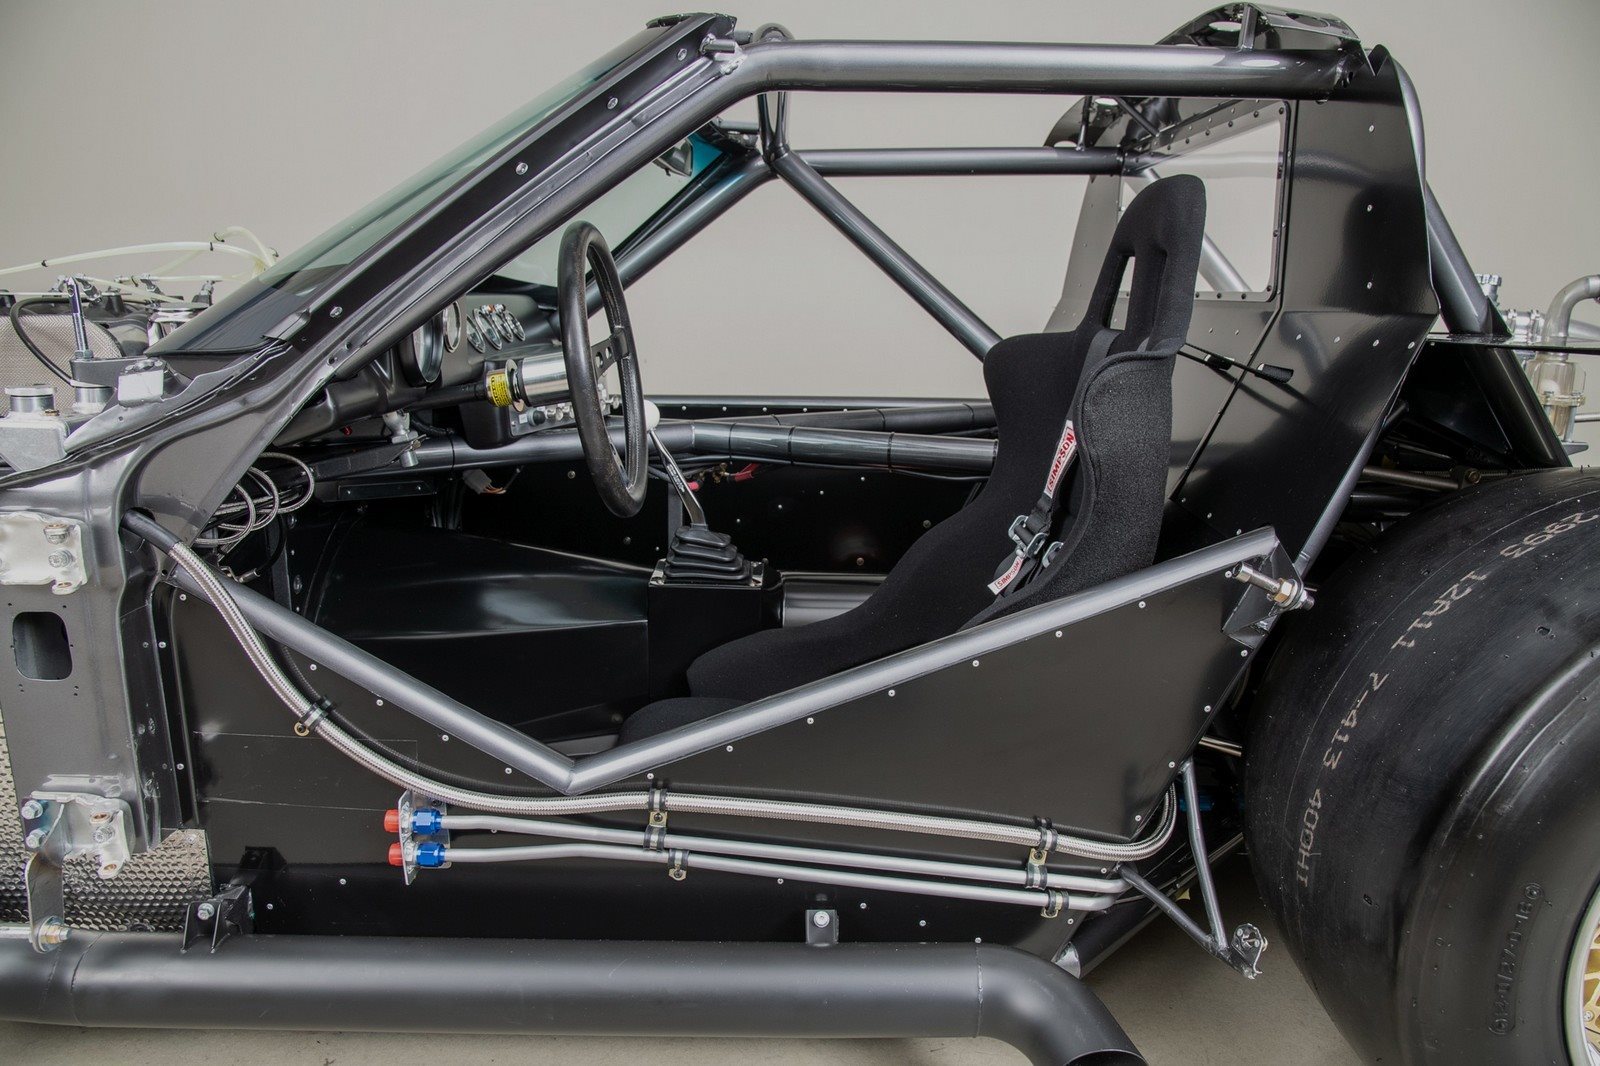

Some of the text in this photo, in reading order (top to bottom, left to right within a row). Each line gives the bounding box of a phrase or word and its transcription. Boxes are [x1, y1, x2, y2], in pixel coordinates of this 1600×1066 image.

[1048, 432, 1075, 488] SIMPSON
[997, 561, 1021, 588] SIMPSON
[1390, 570, 1487, 650] 12A11
